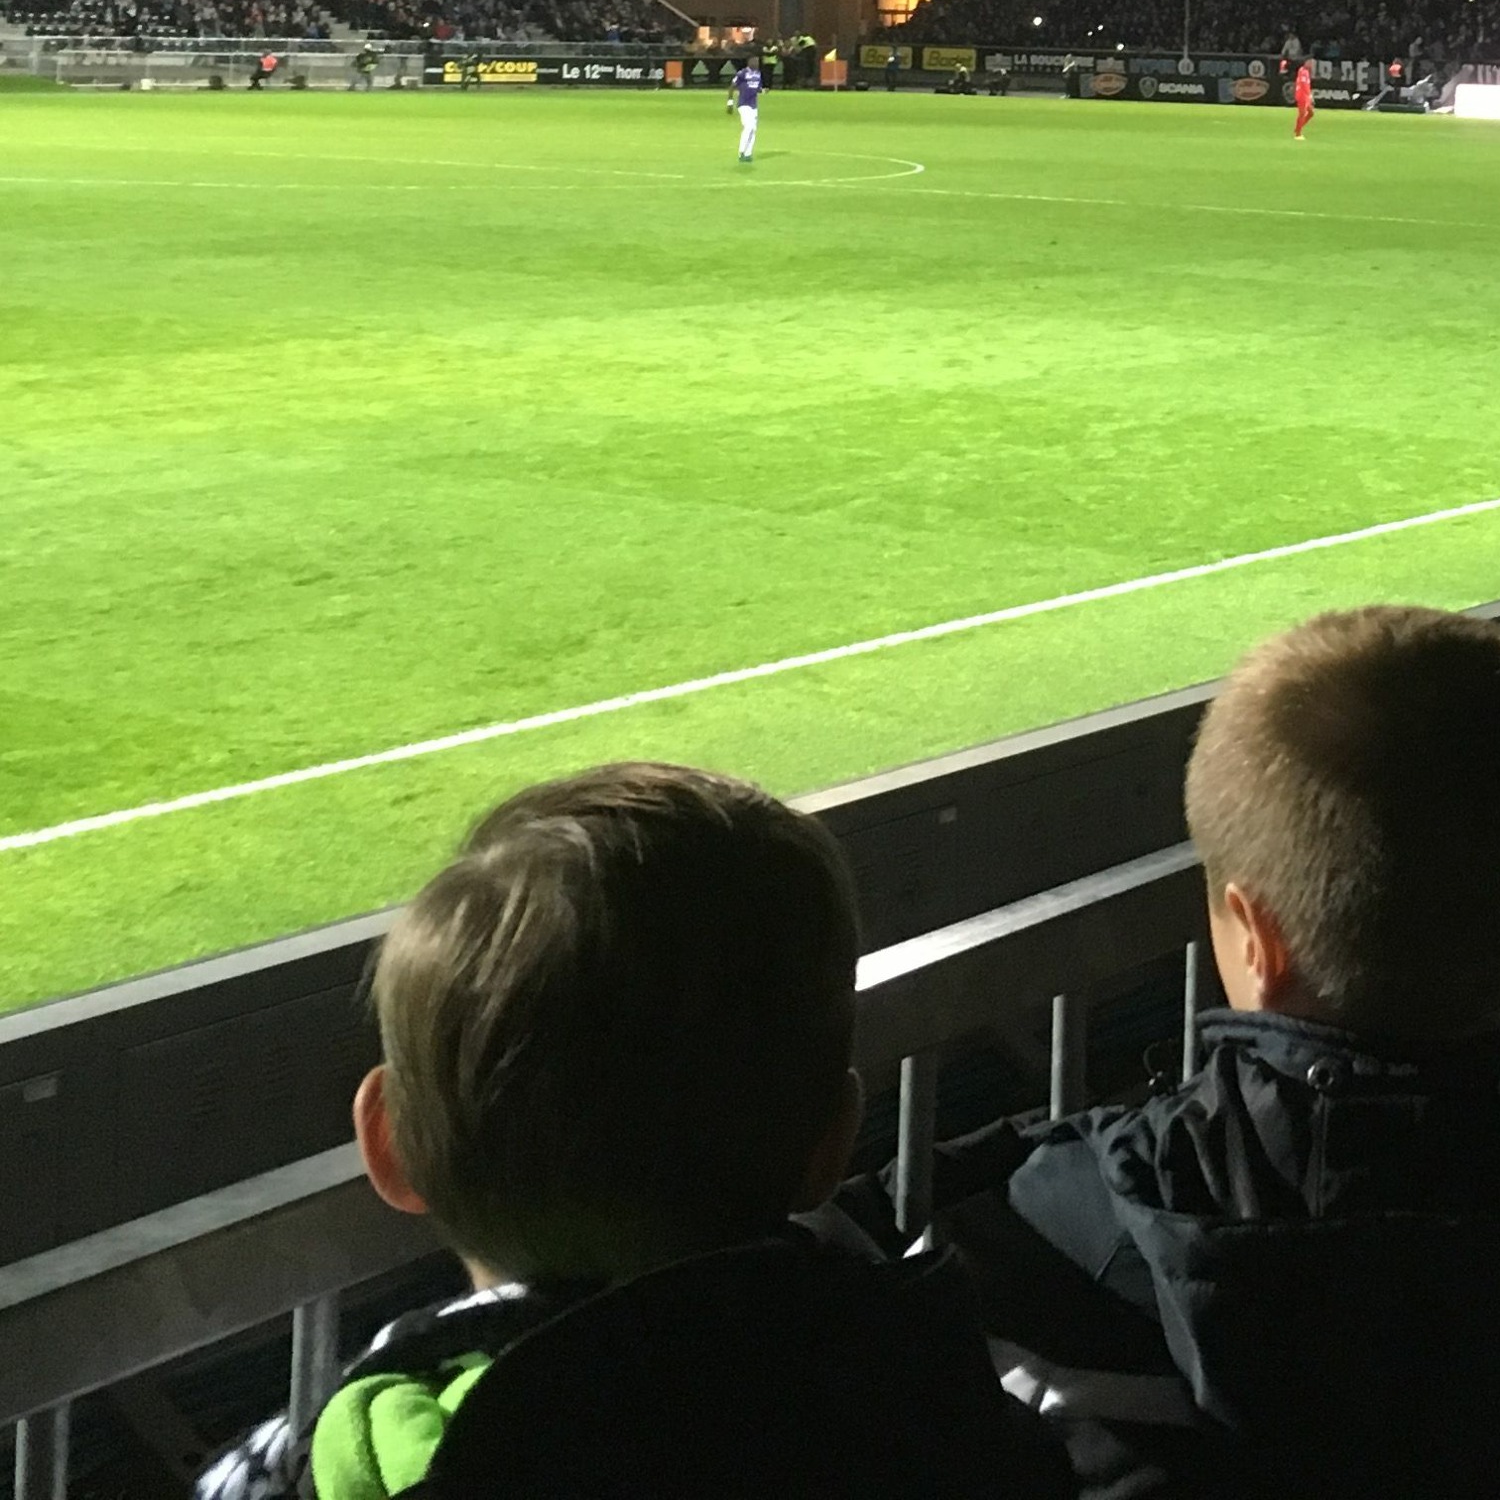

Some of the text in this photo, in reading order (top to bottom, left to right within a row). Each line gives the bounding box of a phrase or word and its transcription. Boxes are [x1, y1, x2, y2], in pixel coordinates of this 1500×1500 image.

[562, 63, 580, 79] Le
[1158, 82, 1205, 95] SCANIA
[1311, 89, 1351, 101] CANIA
